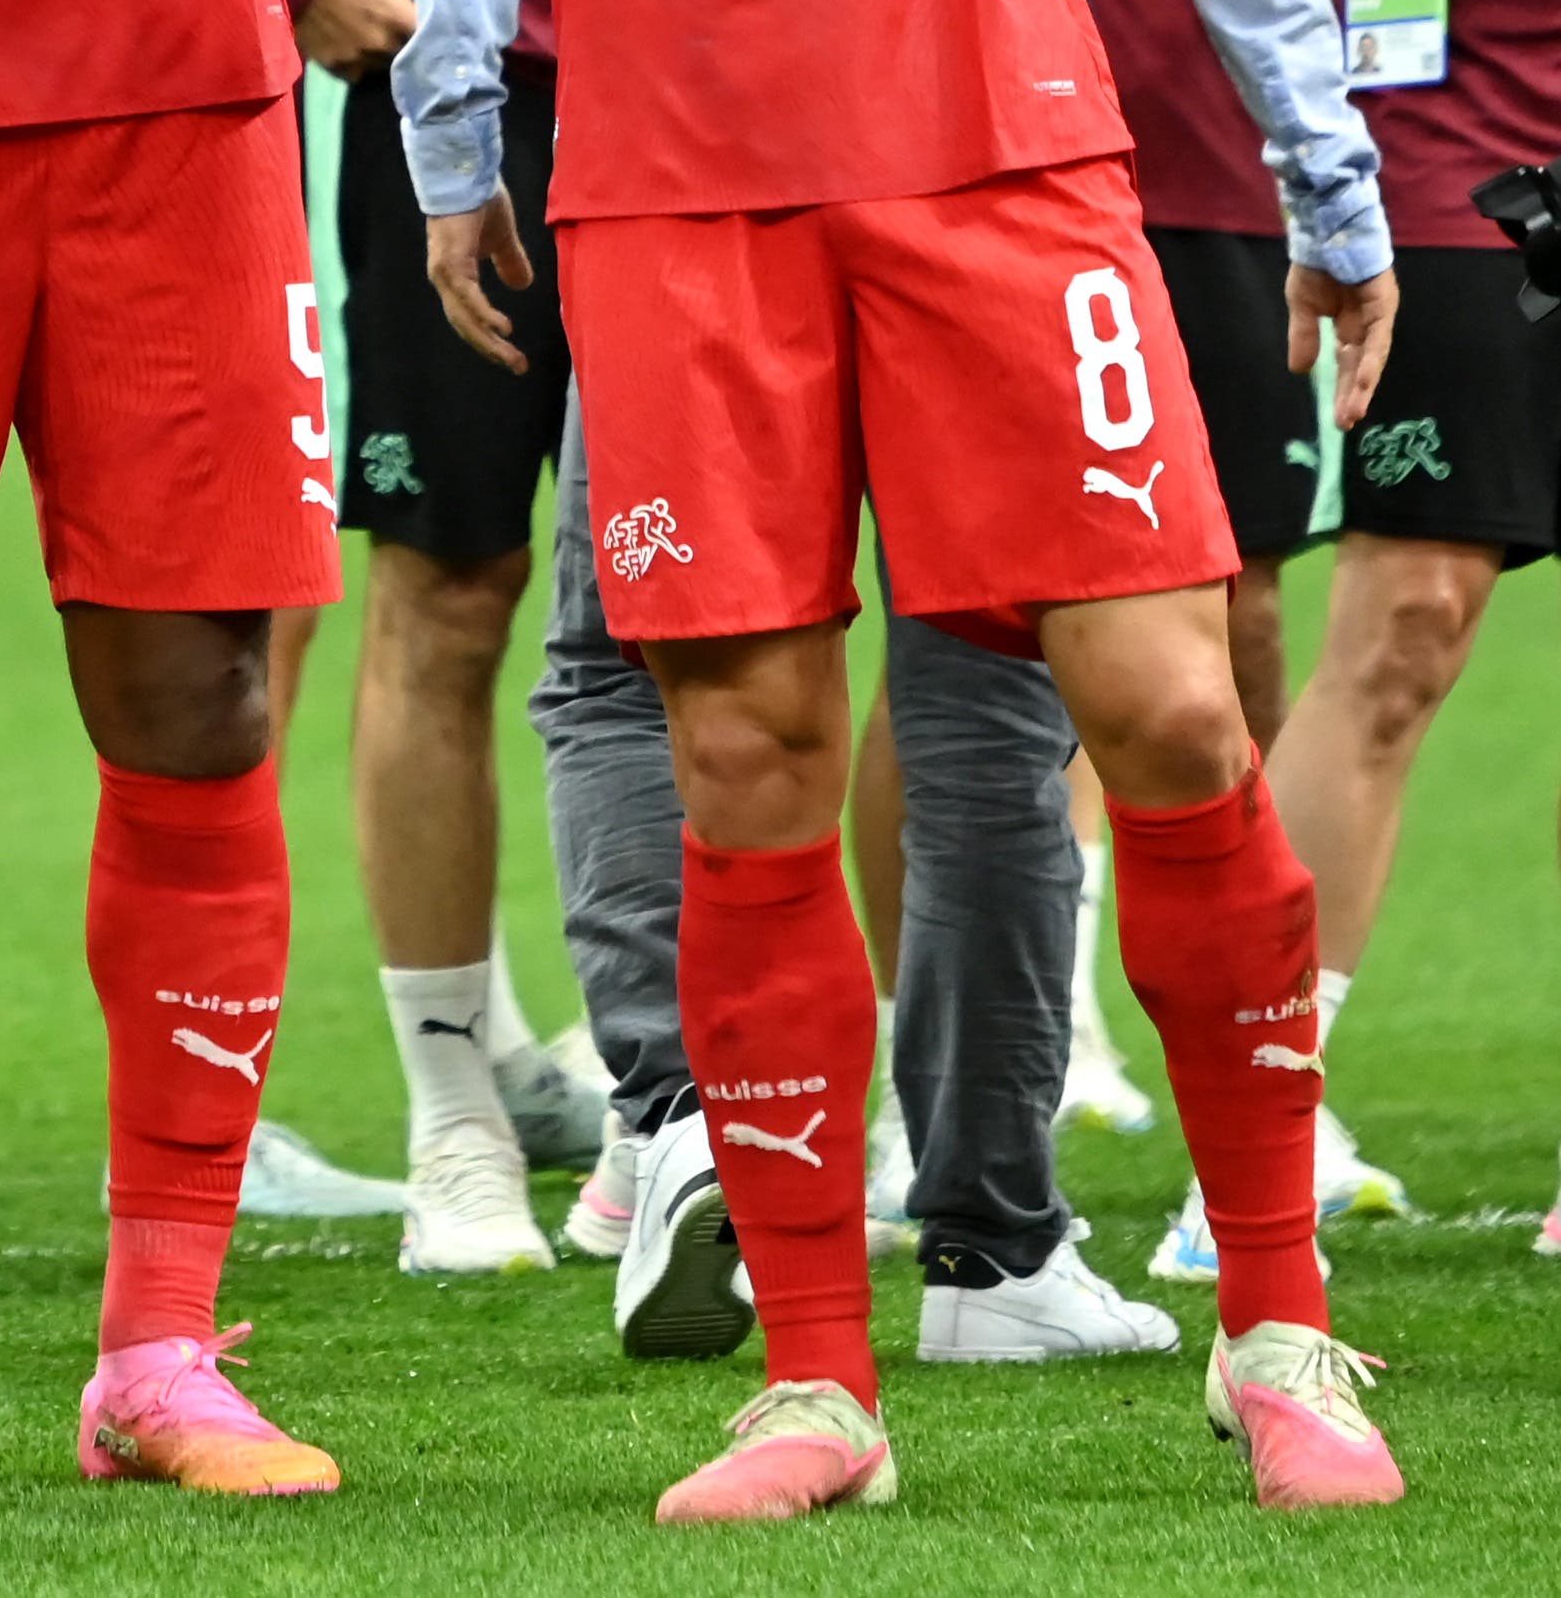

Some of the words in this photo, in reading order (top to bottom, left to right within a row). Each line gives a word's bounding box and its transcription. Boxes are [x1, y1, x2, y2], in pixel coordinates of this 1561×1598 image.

[285, 282, 330, 461] 5
[1065, 266, 1155, 452] 8
[155, 989, 280, 1015] suisse
[1234, 988, 1318, 1024] suis
[704, 1075, 827, 1101] suisse
